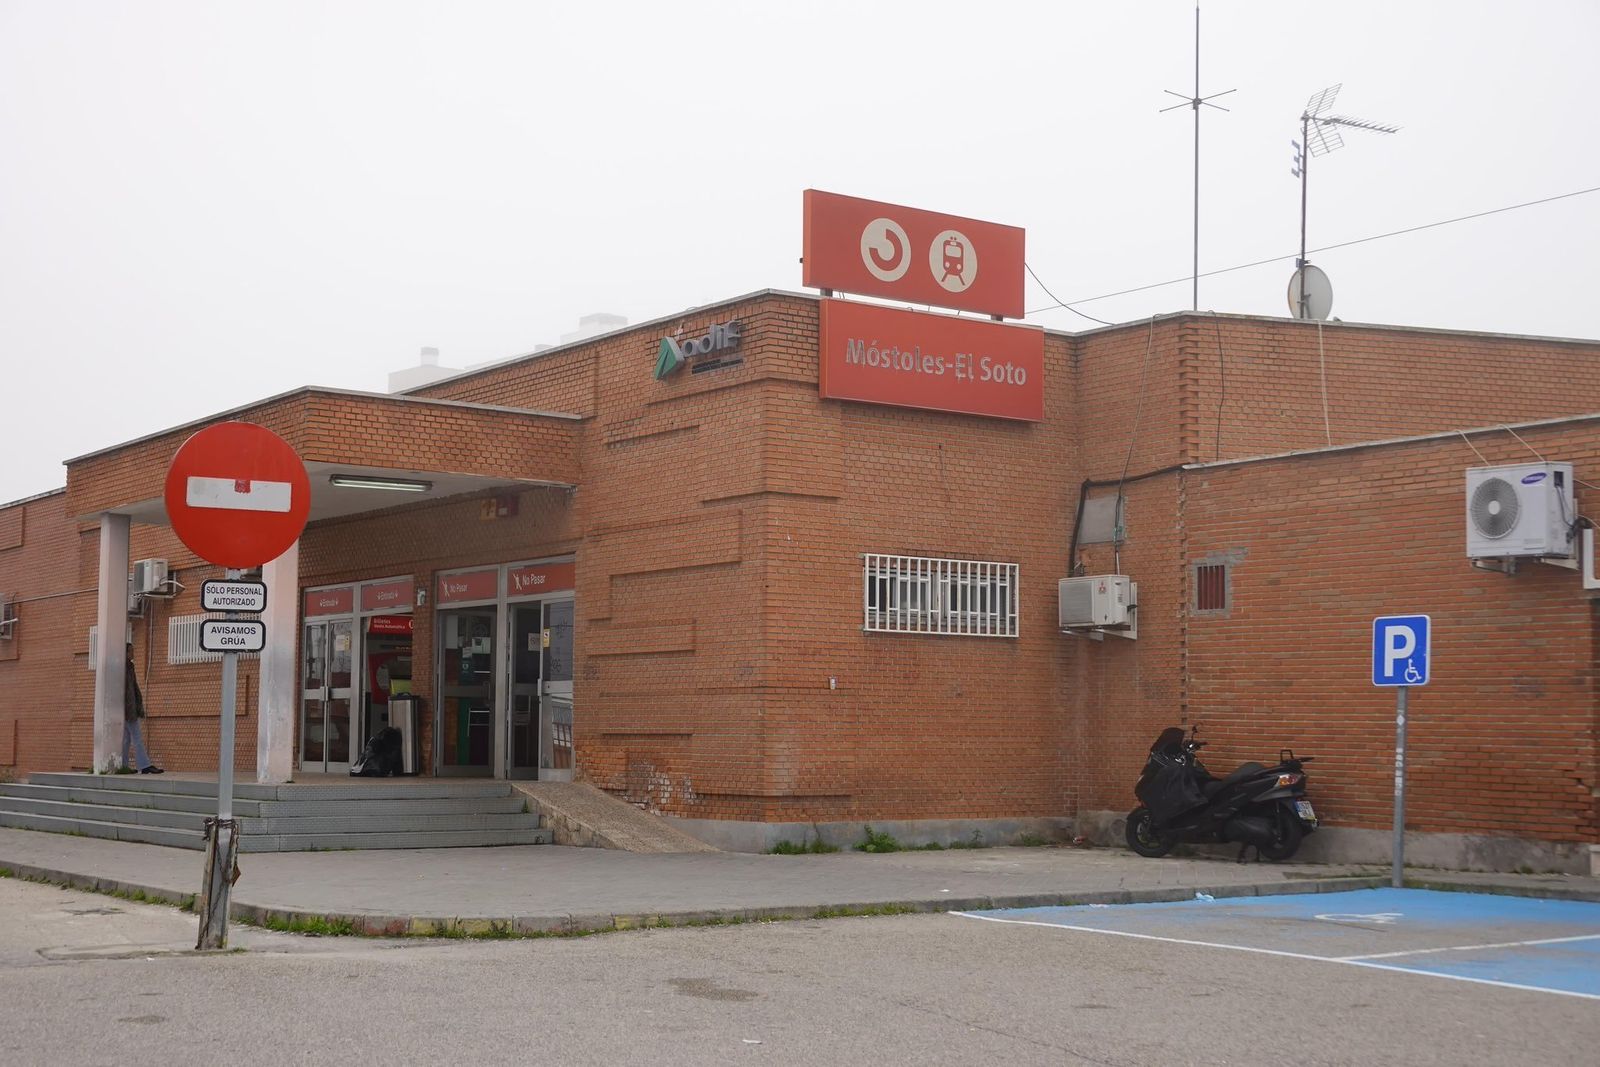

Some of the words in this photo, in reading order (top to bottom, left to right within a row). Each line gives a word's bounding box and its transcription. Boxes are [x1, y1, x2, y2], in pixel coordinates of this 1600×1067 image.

[845, 337, 975, 380] Móstoles-El
[979, 356, 1027, 386] Soto
[522, 575, 530, 586] No
[530, 573, 546, 585] Pasar
[206, 585, 225, 594] SÓLO
[226, 587, 262, 595] PERSONAL
[213, 598, 255, 606] AUTORIZADO
[211, 626, 256, 634] AVISAMOS
[220, 635, 246, 645] GRÚA
[1384, 625, 1416, 677] P
